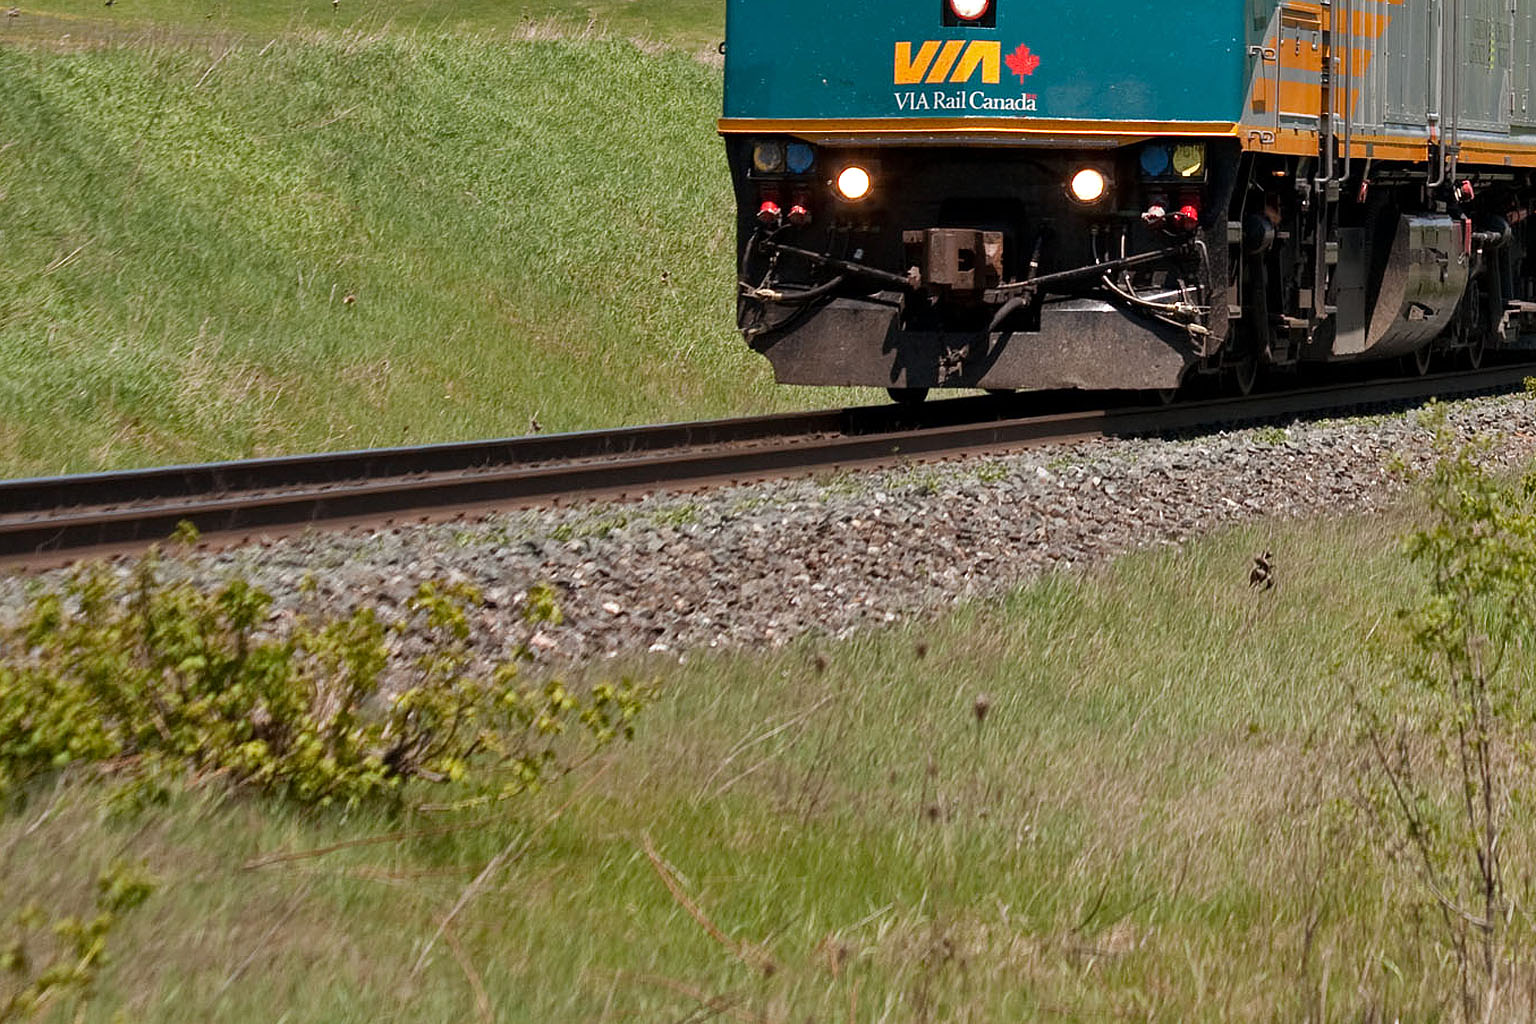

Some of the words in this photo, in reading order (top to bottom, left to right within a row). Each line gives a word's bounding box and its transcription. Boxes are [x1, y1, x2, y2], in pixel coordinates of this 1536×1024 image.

[894, 40, 1001, 84] VIA
[894, 92, 930, 110] VIA
[934, 91, 966, 109] Rail
[969, 91, 1037, 111] Canada
